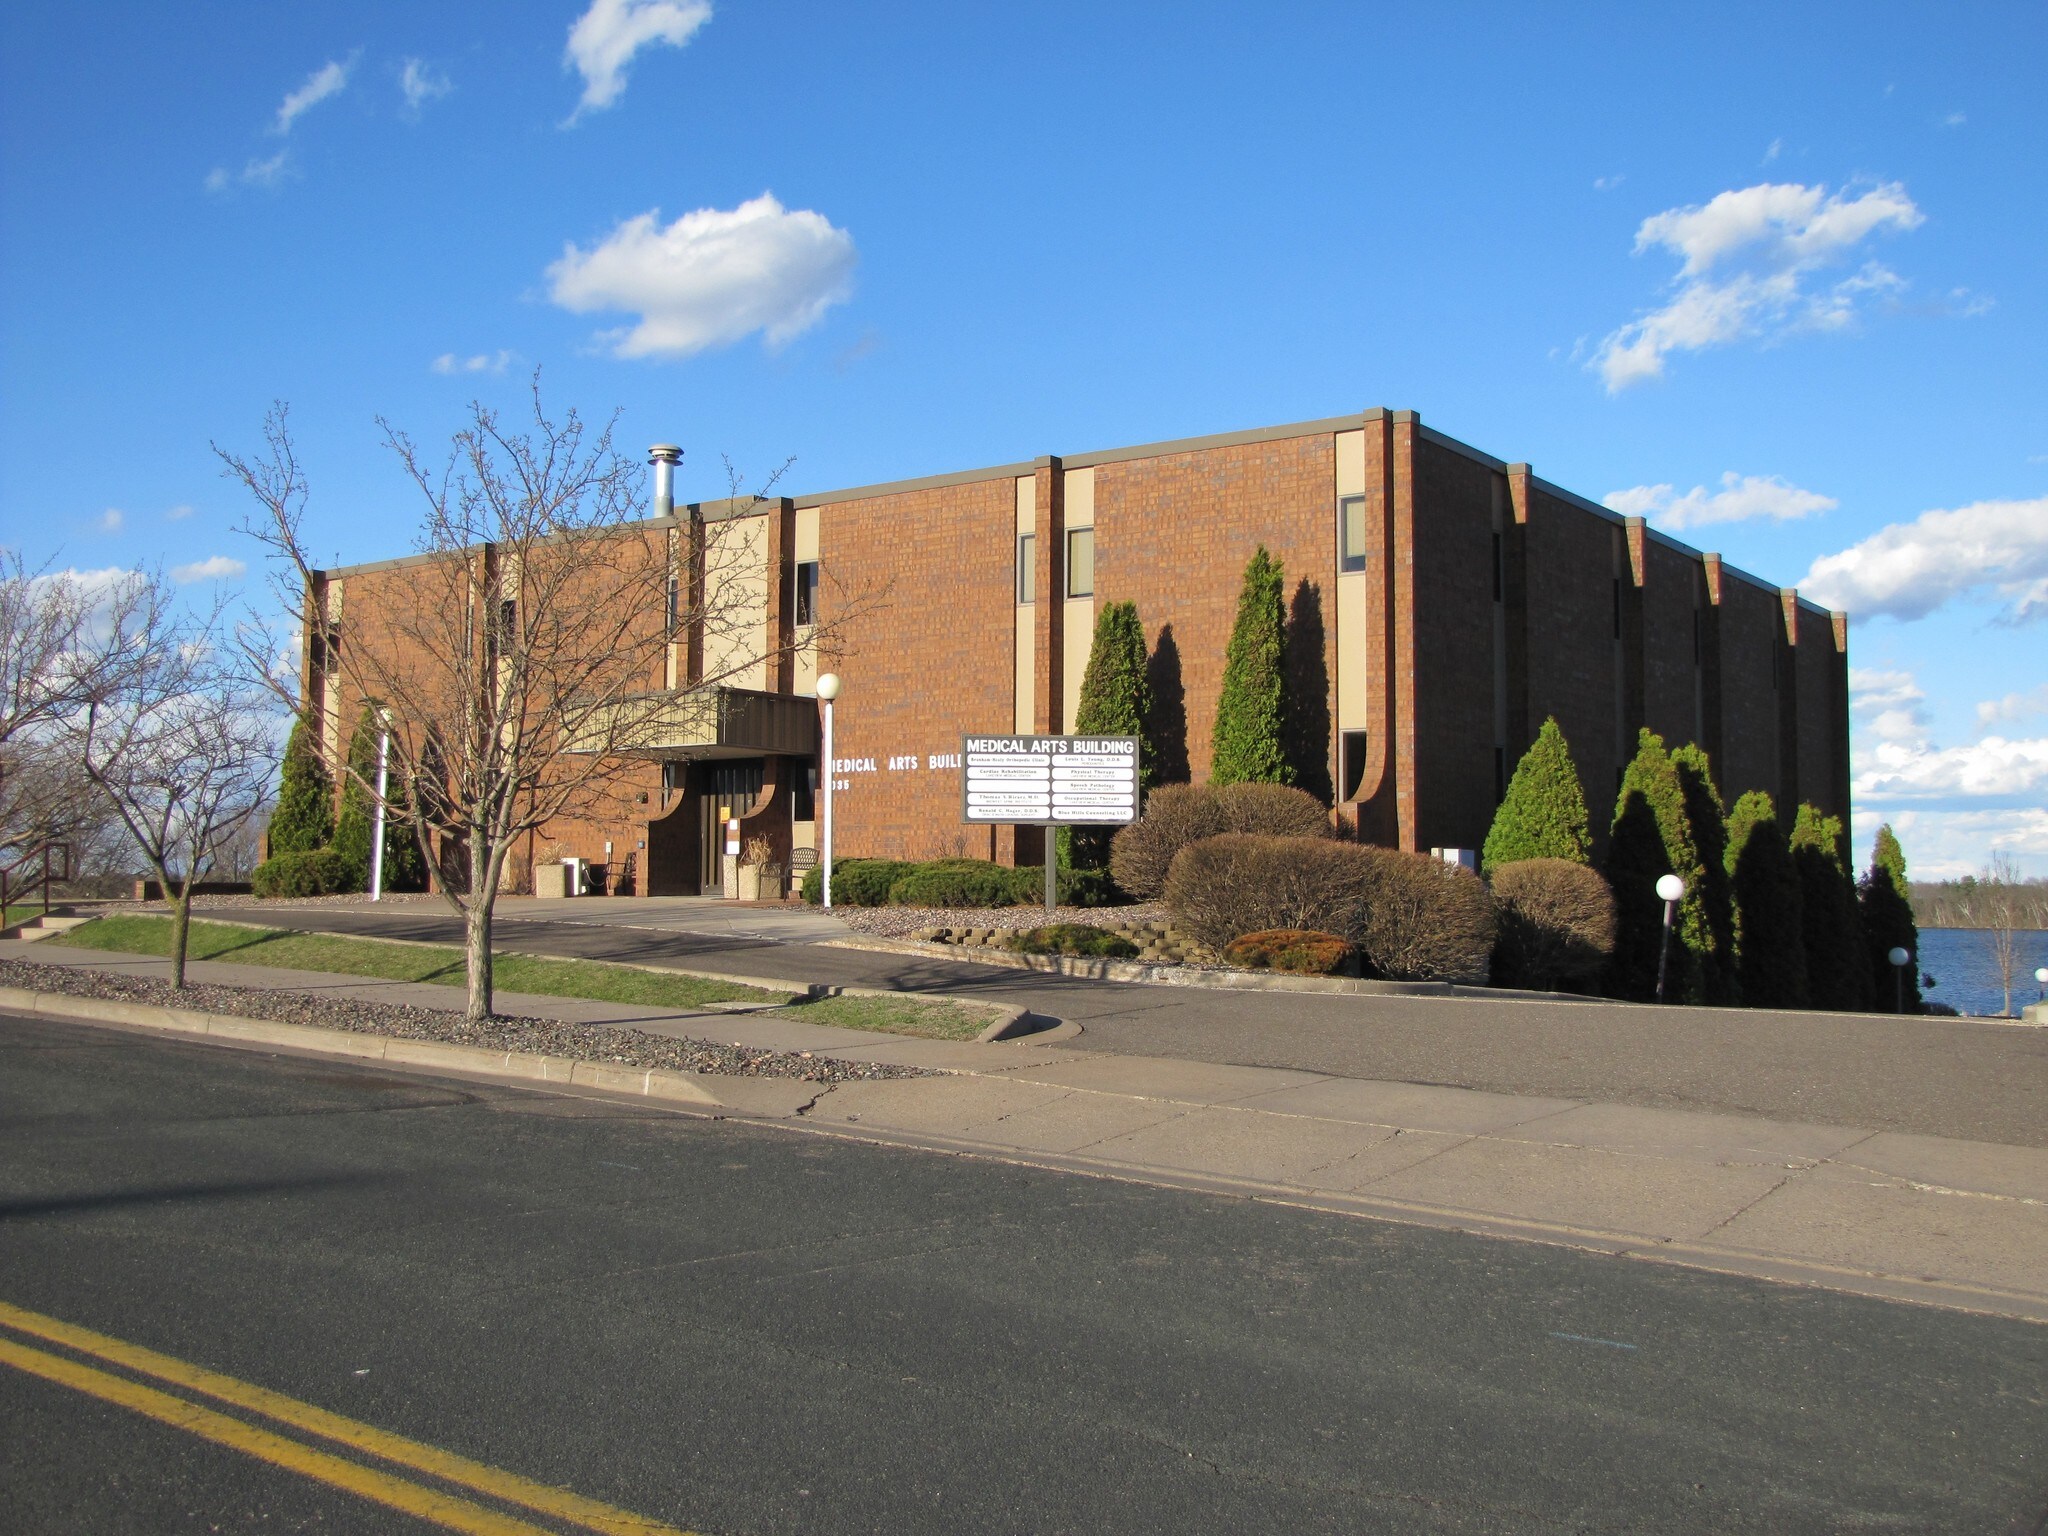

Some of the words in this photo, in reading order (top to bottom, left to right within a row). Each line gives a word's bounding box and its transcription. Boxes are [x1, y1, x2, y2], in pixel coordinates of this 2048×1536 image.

[967, 739, 1027, 752] MEDICAL
[1031, 740, 1067, 753] ARTS
[1073, 740, 1134, 754] BUILDING
[889, 756, 918, 770] ARTS
